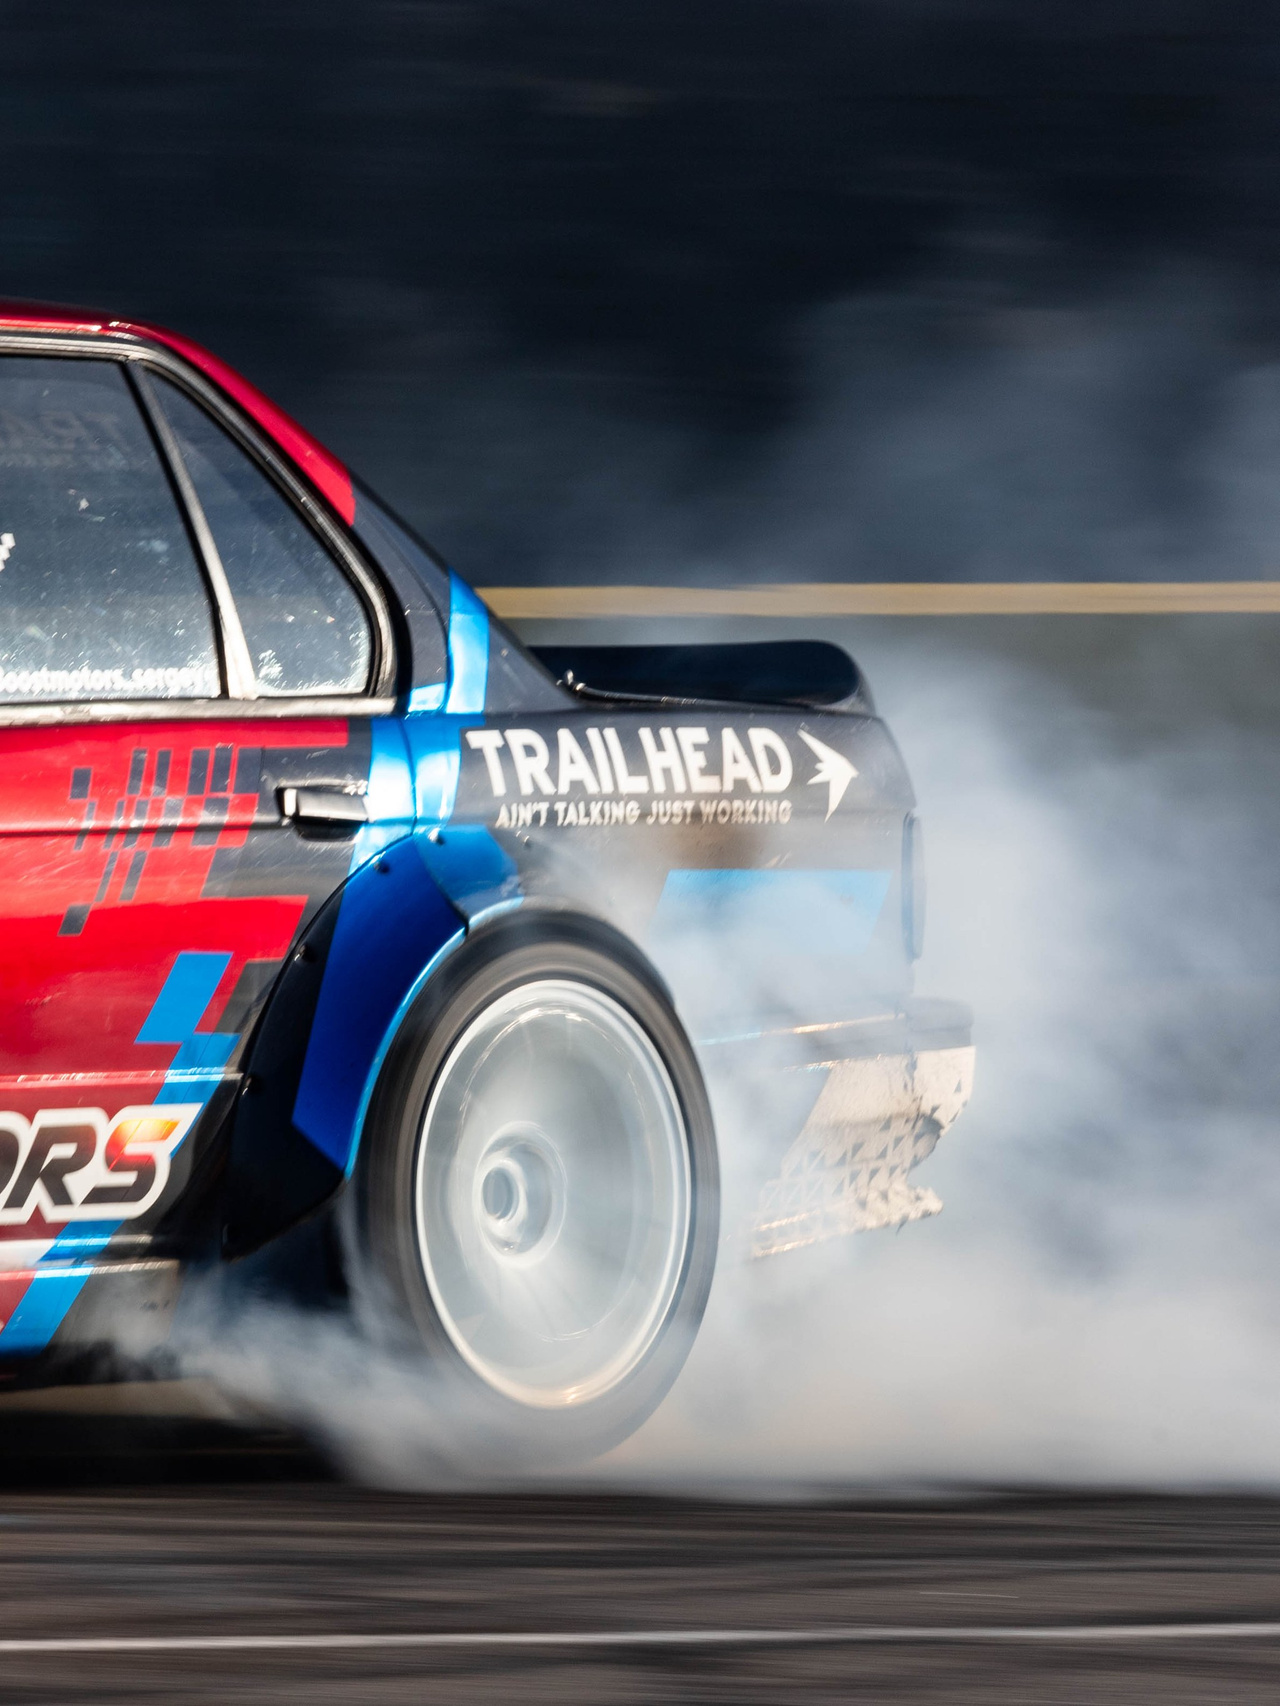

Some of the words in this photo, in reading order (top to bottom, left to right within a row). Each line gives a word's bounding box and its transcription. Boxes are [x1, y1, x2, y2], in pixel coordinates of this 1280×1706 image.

[465, 727, 793, 797] TRAILHEAD
[553, 799, 641, 826] TALKING
[646, 799, 696, 825] JUST
[699, 798, 793, 824] WORKING
